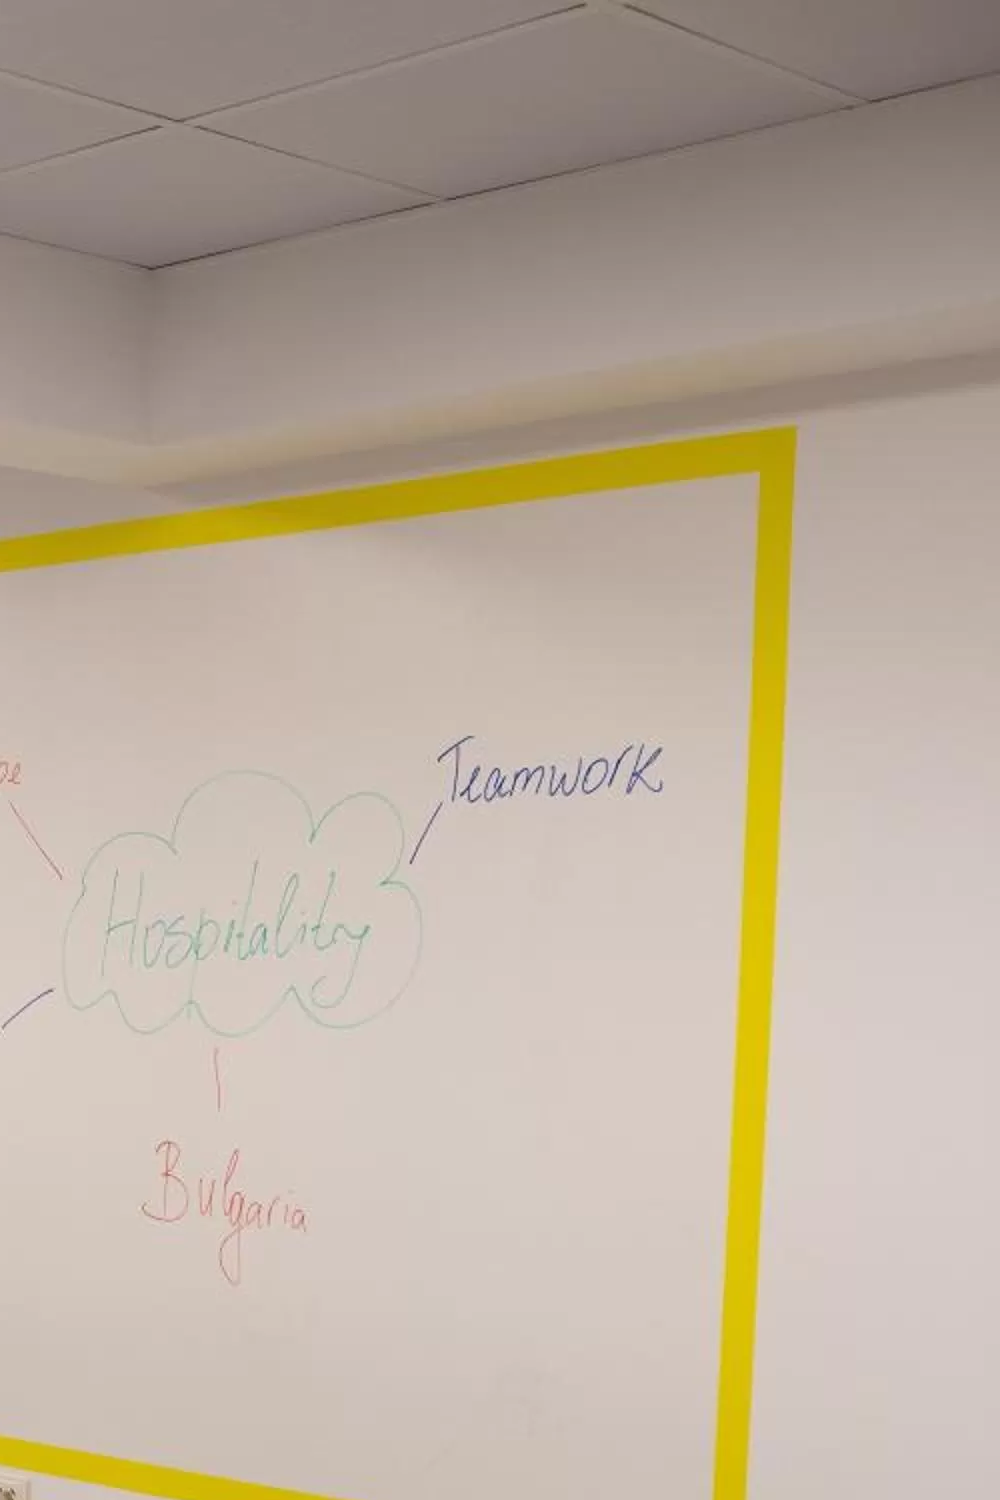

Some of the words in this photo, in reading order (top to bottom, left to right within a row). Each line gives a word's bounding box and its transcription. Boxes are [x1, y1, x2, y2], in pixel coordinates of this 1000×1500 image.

[436, 734, 664, 804] Teamwork
[100, 858, 373, 1020] Hospitality
[140, 1139, 308, 1288] Bulgaria
